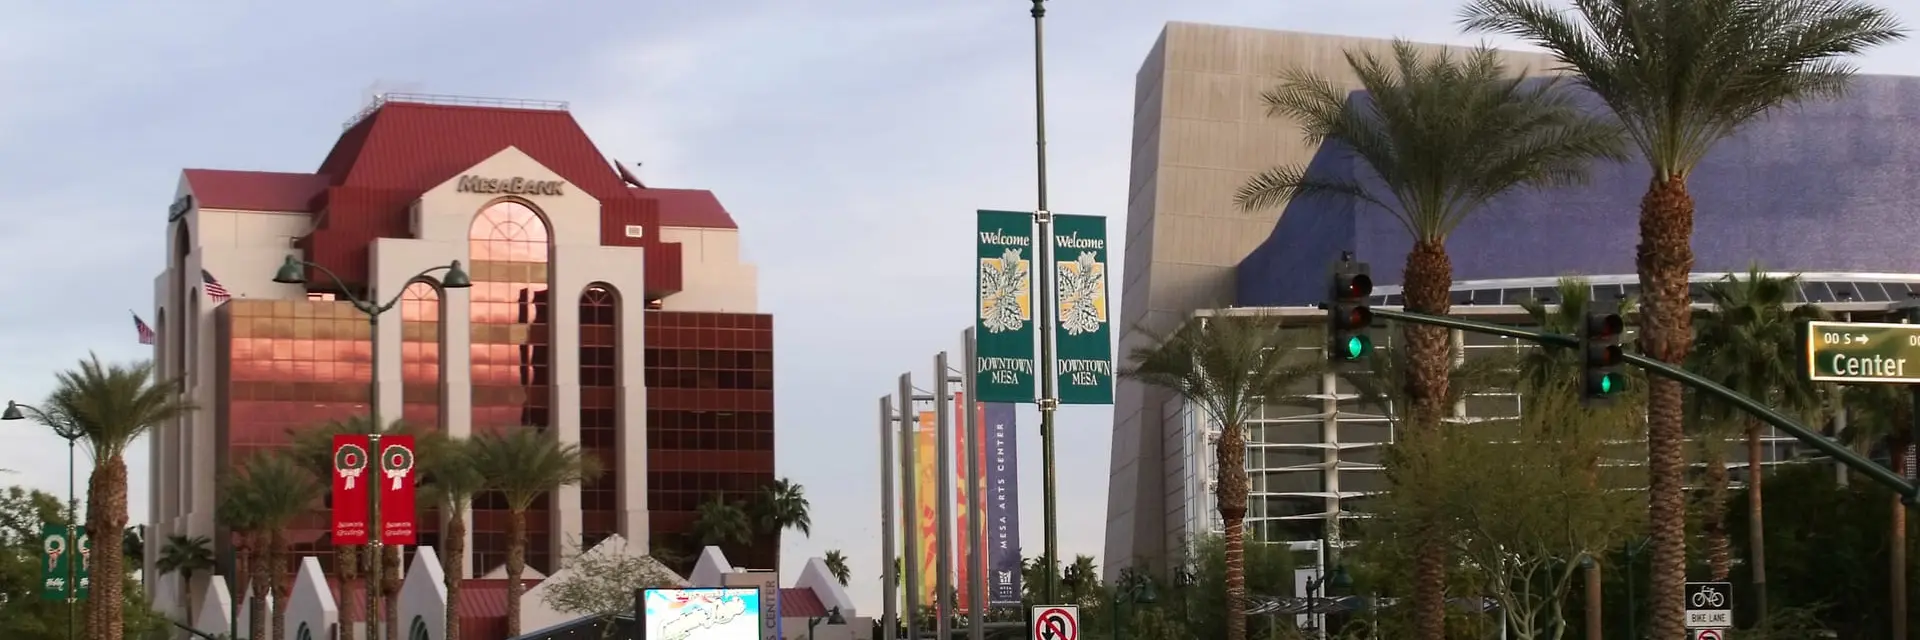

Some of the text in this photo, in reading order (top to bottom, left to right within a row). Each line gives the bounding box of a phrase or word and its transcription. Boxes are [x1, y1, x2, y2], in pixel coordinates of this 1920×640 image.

[980, 228, 1030, 246] Welcome
[1056, 231, 1104, 249] Welcome
[1844, 333, 1852, 345] S
[978, 357, 1033, 375] DOWNTOWN
[1059, 359, 1111, 376] DOWNTOWN
[1833, 353, 1907, 377] Center
[992, 370, 1019, 385] MESA
[1072, 372, 1098, 386] MESA
[996, 423, 1008, 549] MESA ARTS CENTER
[765, 580, 776, 629] CENTER
[1691, 613, 1726, 623] BIKE LANE
